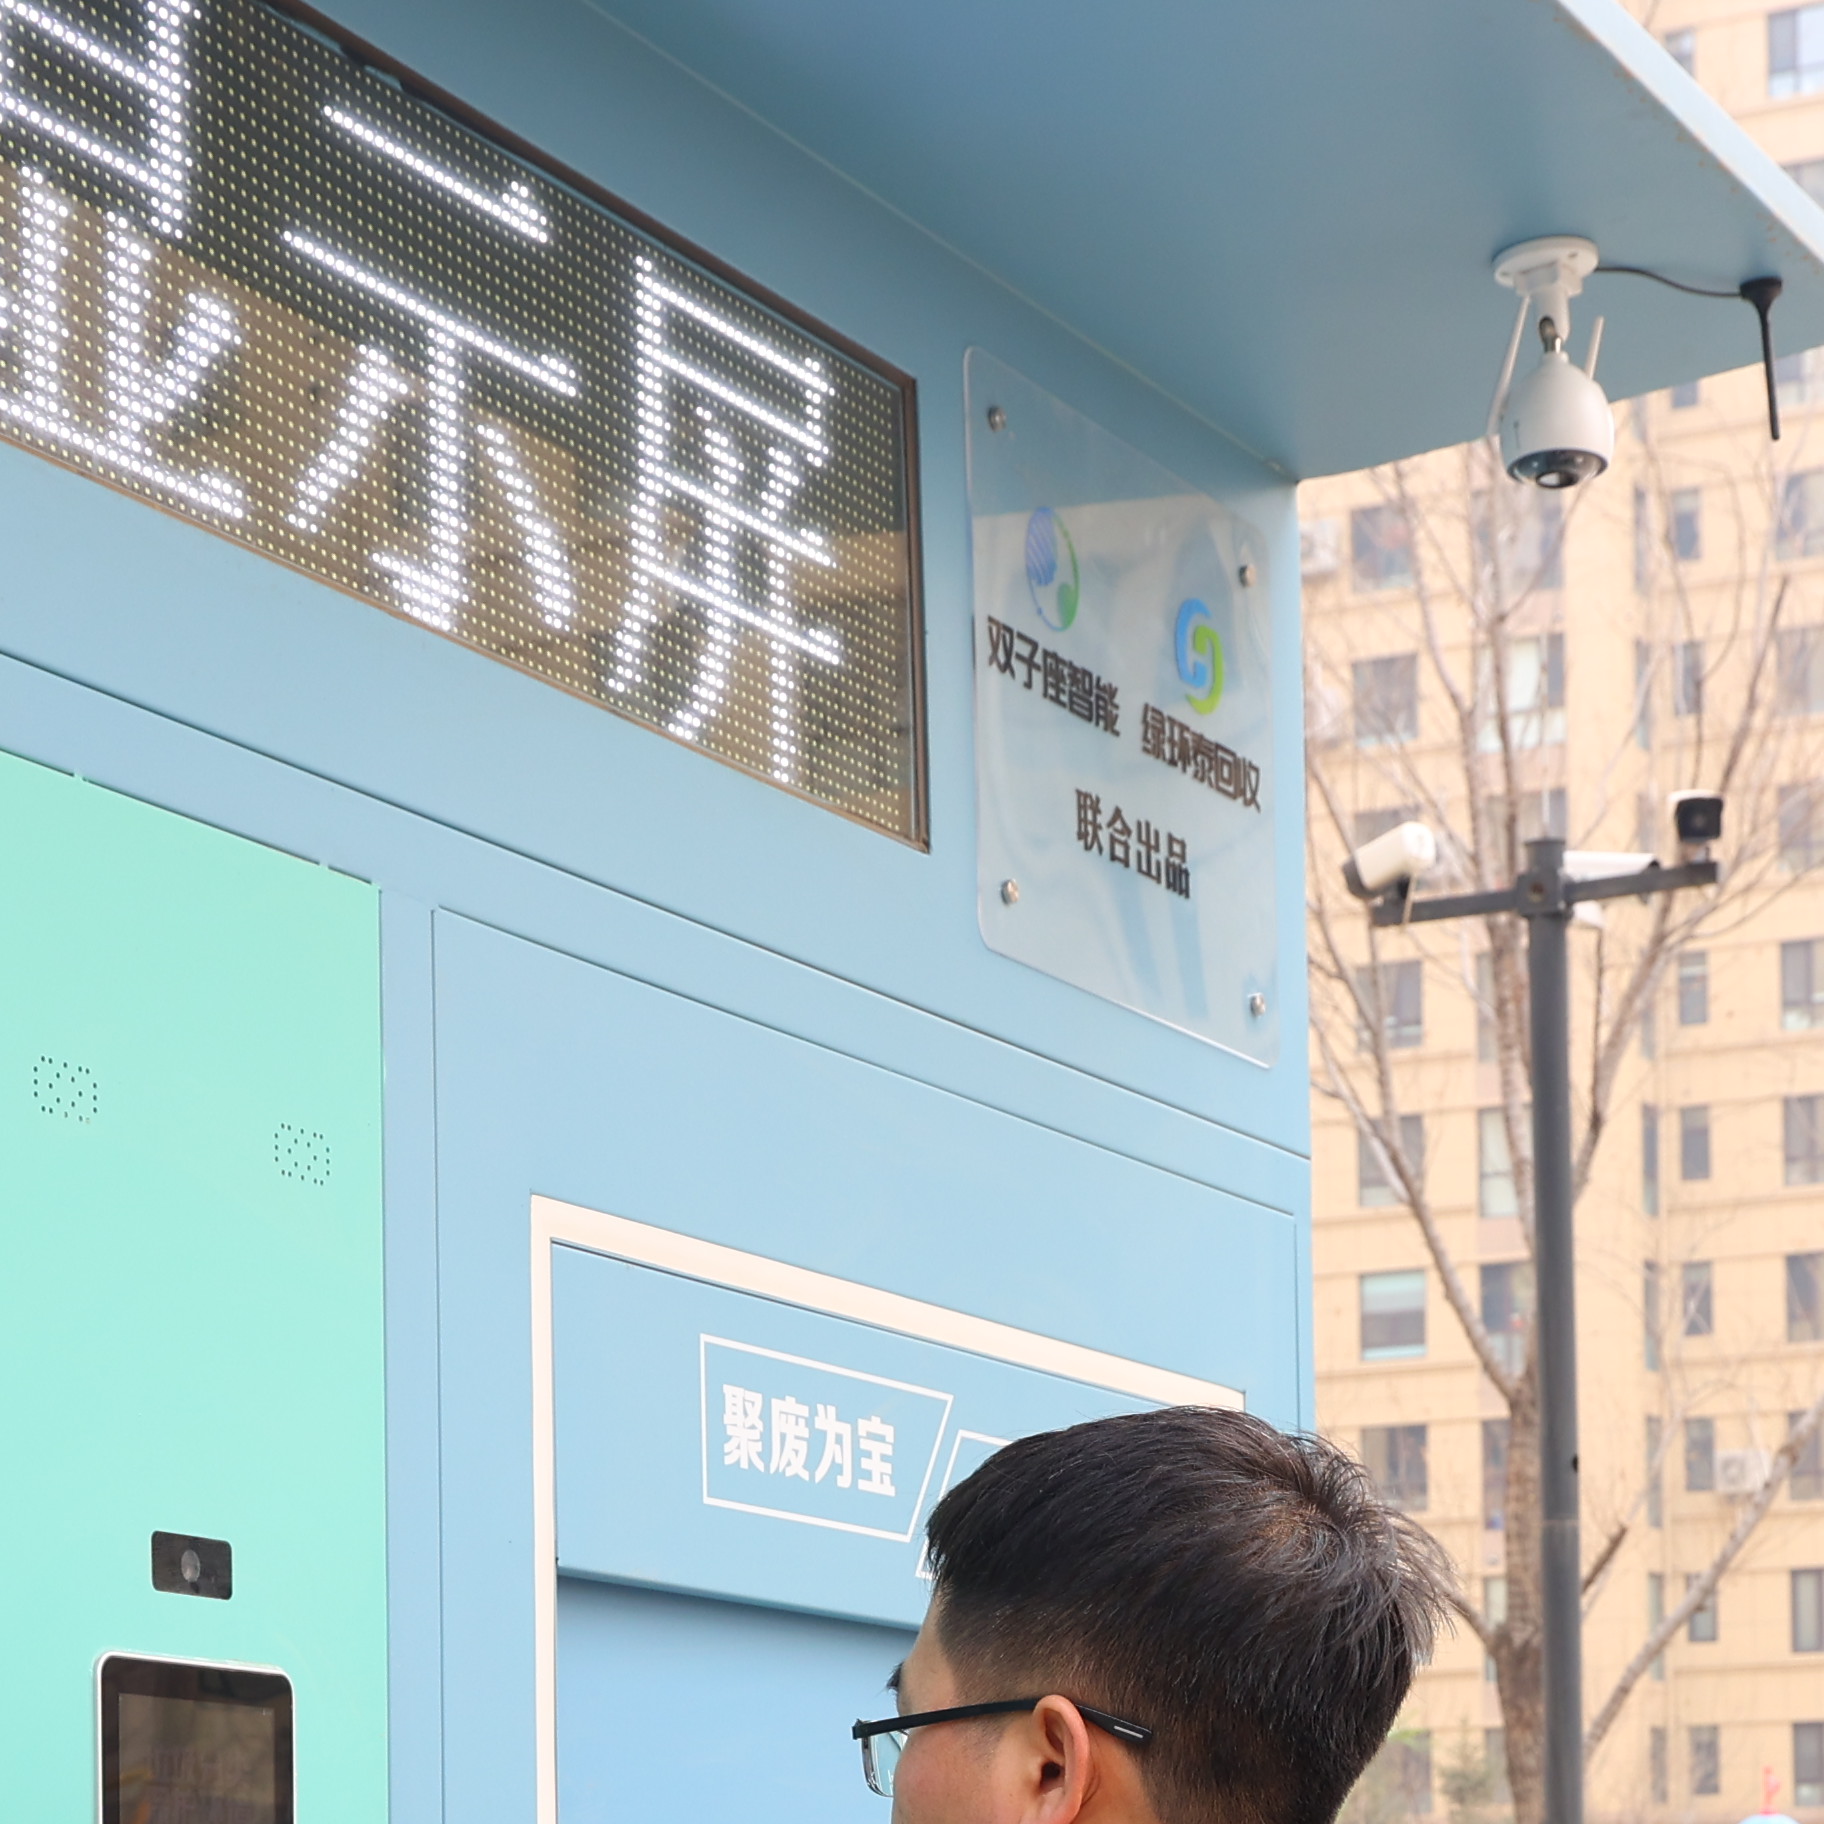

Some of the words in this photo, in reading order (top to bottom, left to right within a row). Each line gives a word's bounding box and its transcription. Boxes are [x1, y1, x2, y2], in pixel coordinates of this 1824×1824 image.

[987, 615, 1120, 737] 双子座智能
[1142, 702, 1261, 813] 绿环泰回收
[1075, 790, 1190, 898] 联合出品
[722, 1384, 896, 1496] 聚废为宝
